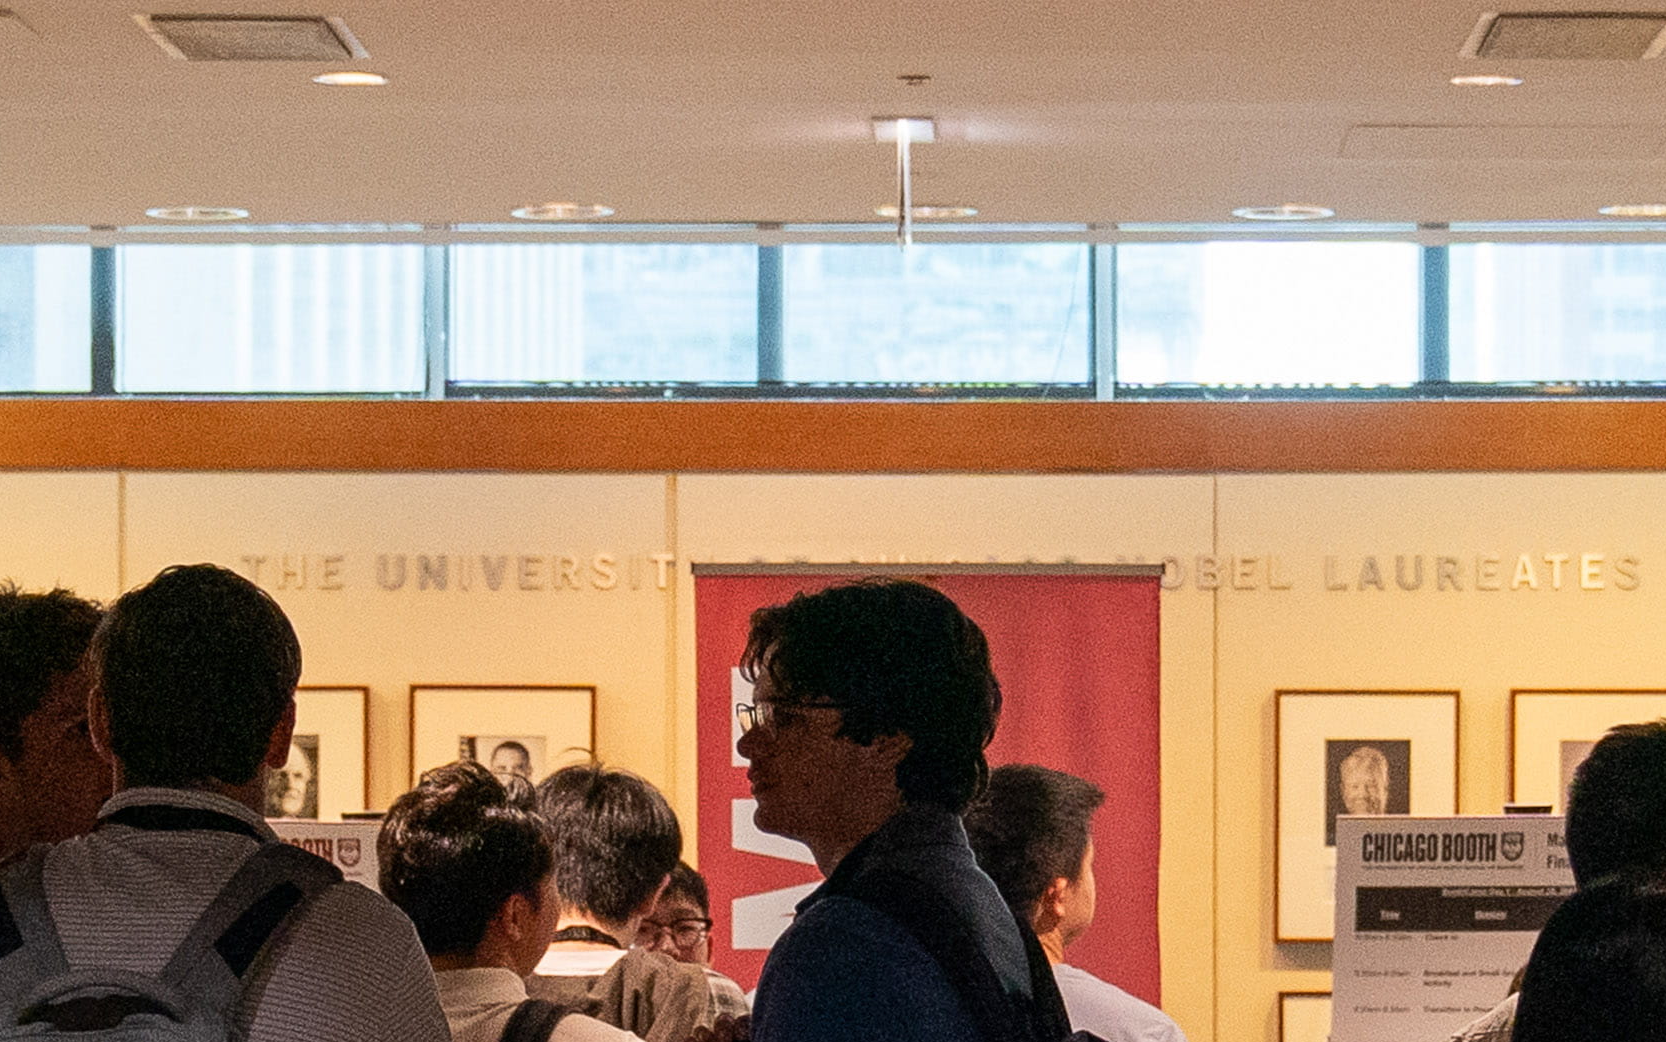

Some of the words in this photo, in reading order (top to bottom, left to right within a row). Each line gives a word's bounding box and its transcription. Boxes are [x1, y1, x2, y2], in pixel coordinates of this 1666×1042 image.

[240, 554, 344, 592] THE
[374, 553, 679, 593] UNIVERSIT
[1160, 554, 1295, 592] OBEL
[1324, 553, 1640, 592] LAUREATES
[1362, 833, 1438, 862] CHICAGO
[1441, 832, 1497, 862] BOOTH
[1546, 832, 1567, 848] Ma
[1546, 856, 1571, 869] Fin
